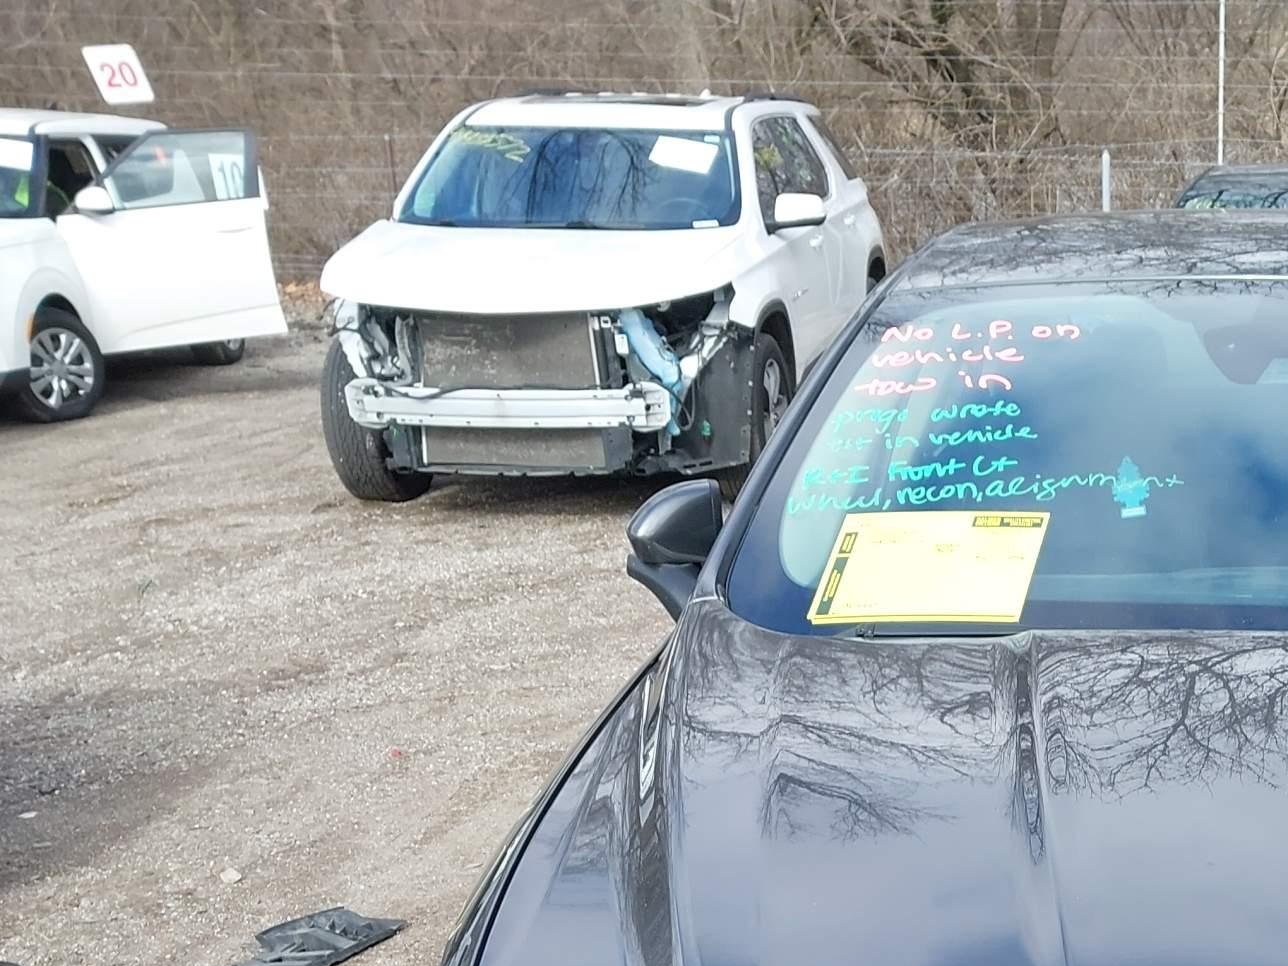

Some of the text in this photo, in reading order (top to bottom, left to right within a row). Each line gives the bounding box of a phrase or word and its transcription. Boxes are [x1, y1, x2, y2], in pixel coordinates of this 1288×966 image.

[100, 61, 139, 88] 20
[880, 324, 934, 344] No
[1031, 323, 1081, 340] on
[871, 345, 1025, 368] vehicle
[957, 370, 1013, 391] in
[884, 432, 920, 450] in
